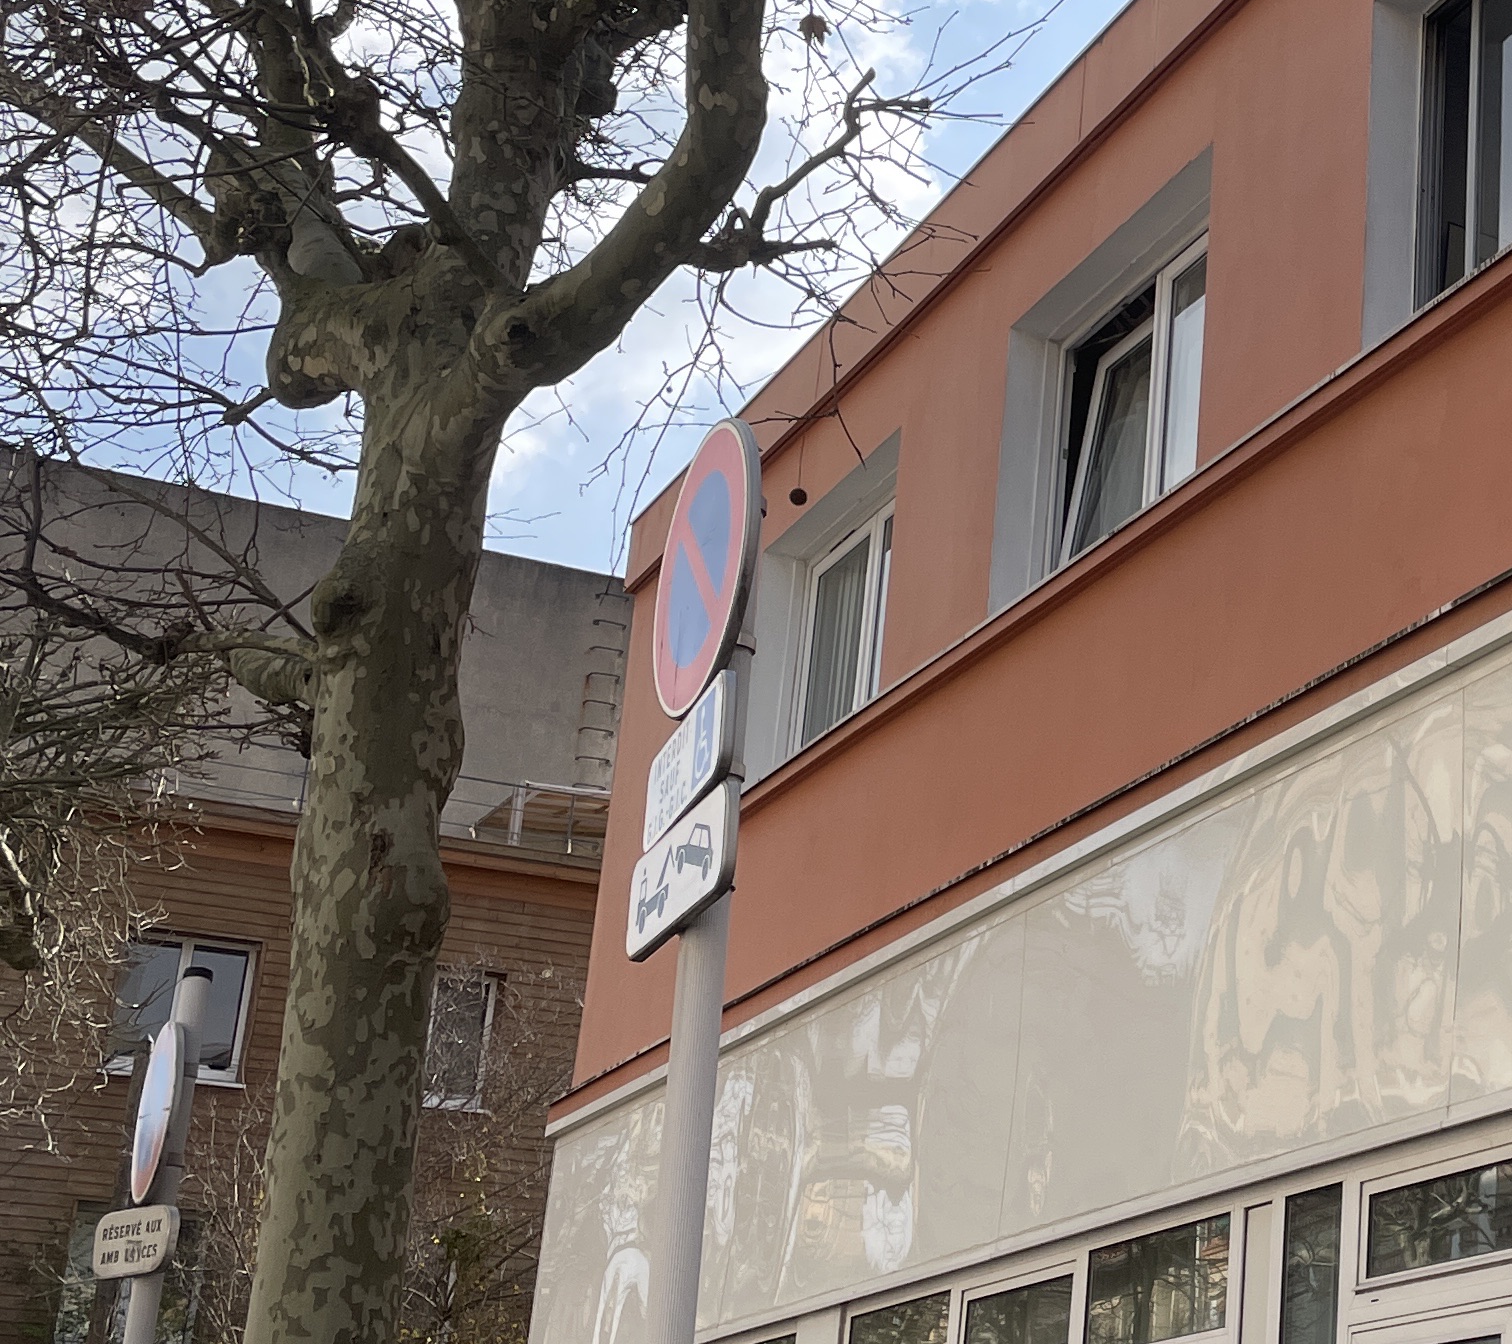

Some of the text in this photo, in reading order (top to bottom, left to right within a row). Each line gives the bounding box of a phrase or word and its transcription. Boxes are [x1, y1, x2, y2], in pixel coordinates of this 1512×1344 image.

[653, 718, 691, 785] INTERDIT
[659, 760, 681, 805] SAUF
[102, 1219, 162, 1241] RÉSERVÉ AUX
